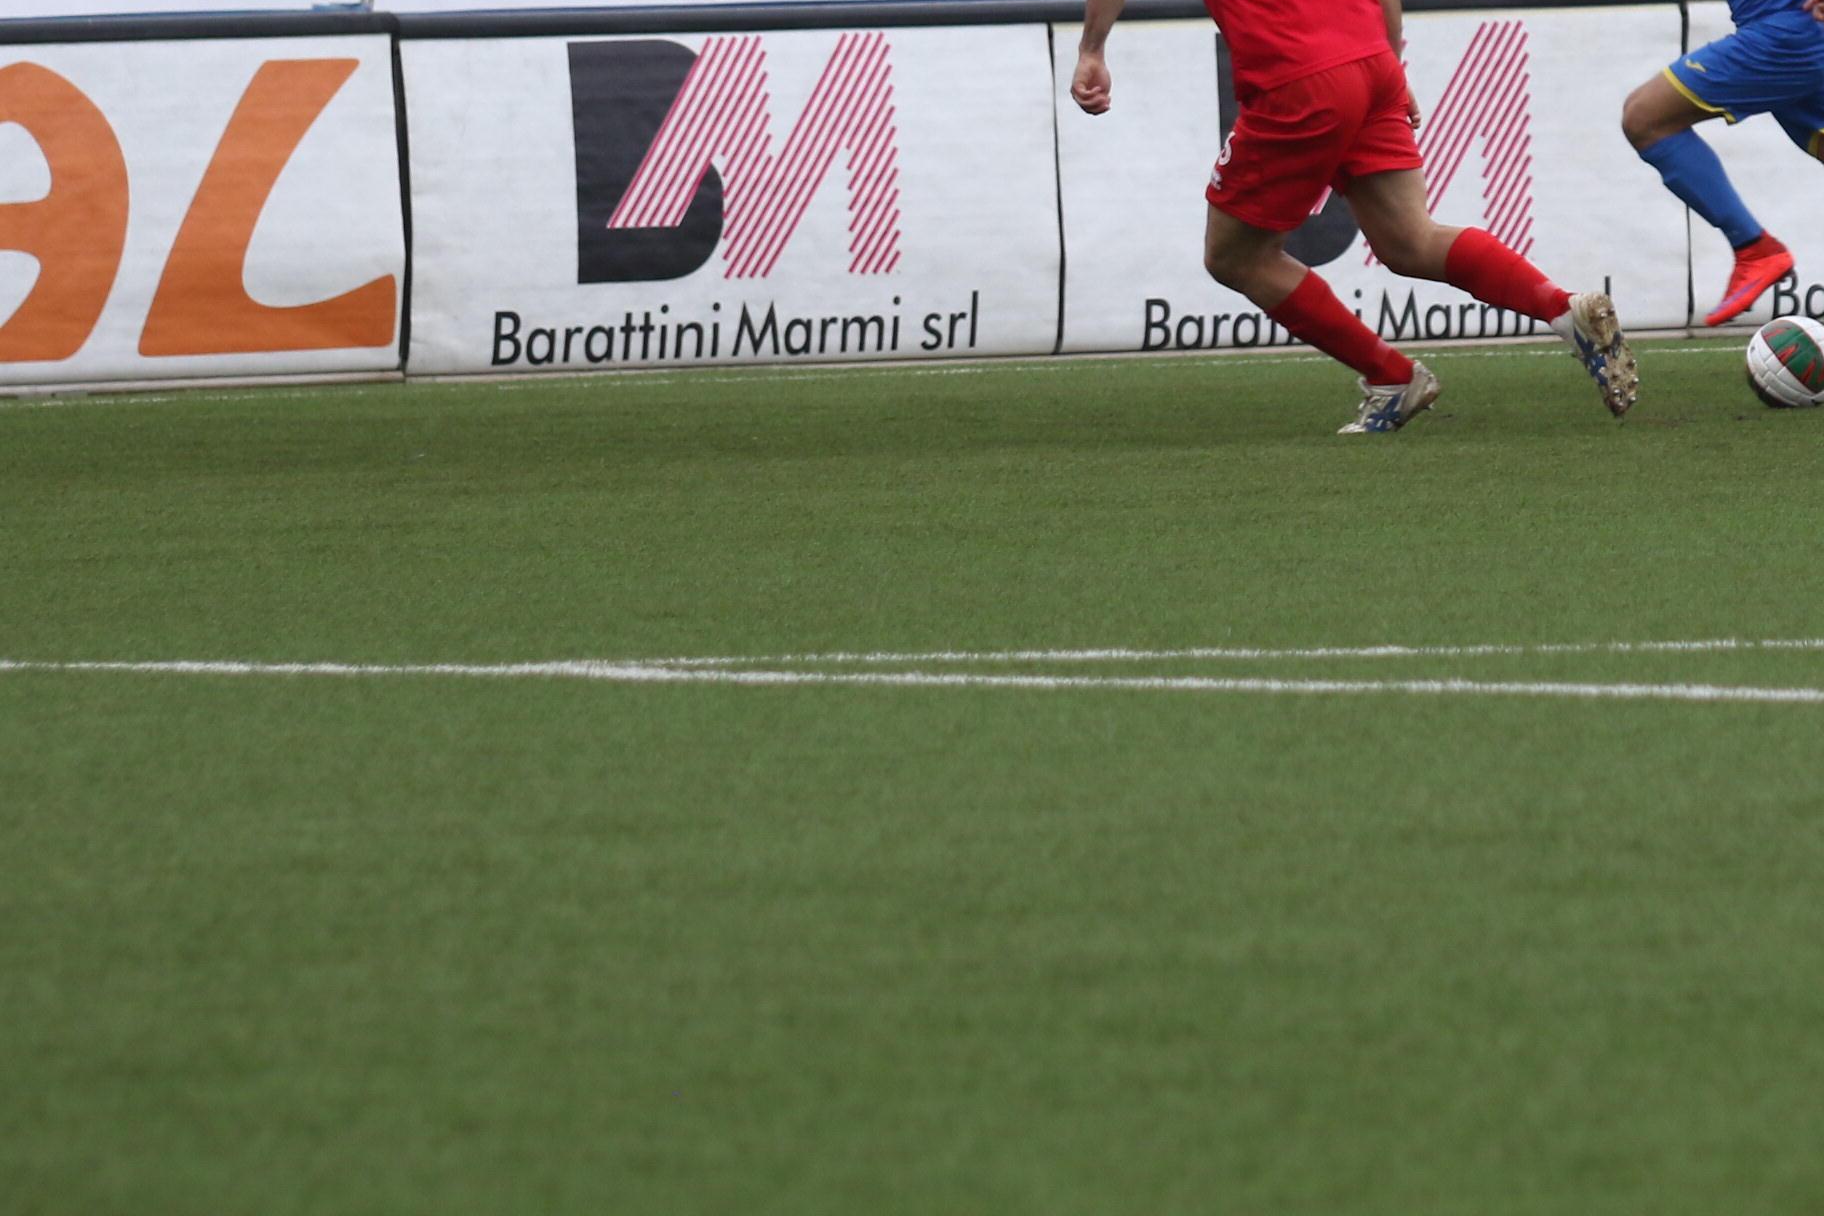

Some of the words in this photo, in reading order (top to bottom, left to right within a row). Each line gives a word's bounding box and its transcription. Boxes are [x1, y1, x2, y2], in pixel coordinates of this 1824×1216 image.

[491, 302, 722, 366] Barattini
[731, 295, 902, 358] Marmi
[920, 290, 980, 352] srl
